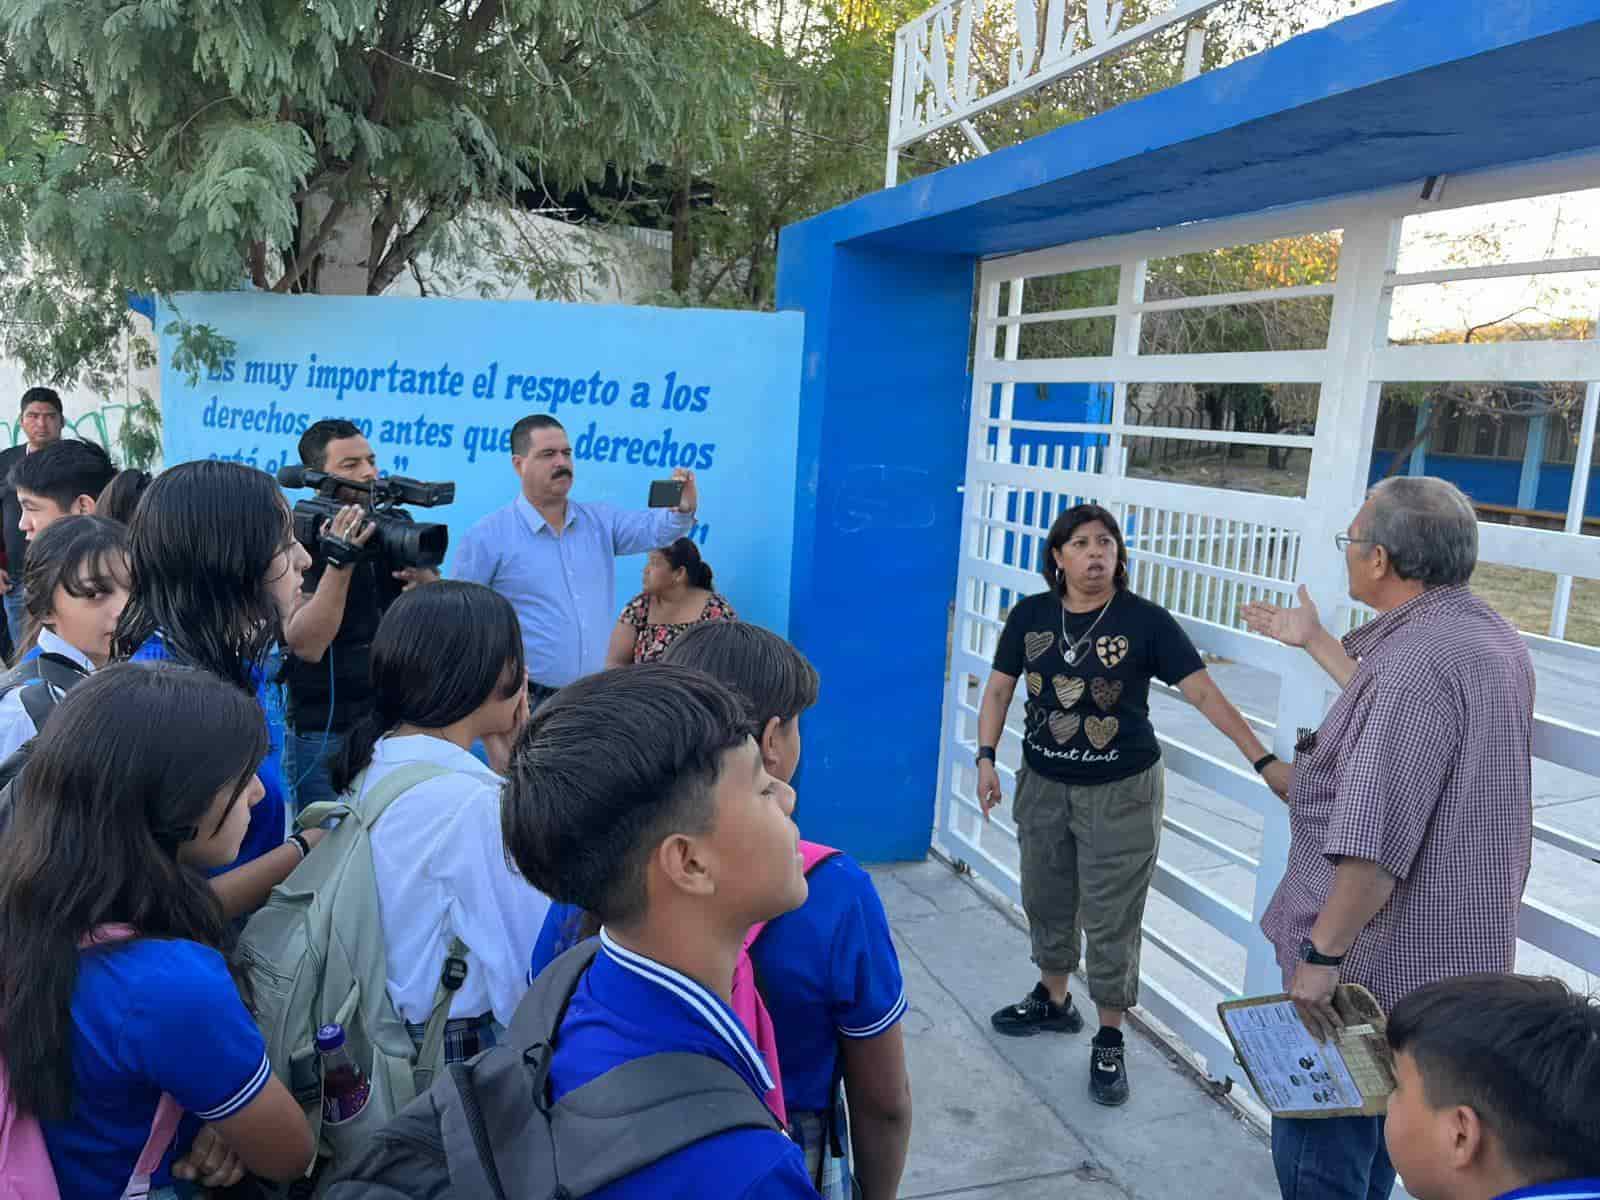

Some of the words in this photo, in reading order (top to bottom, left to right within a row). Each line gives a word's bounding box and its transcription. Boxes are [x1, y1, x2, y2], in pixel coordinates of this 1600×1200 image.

[243, 358, 298, 391] muy
[305, 353, 464, 400] importante
[472, 361, 498, 399] el
[504, 370, 620, 414] respeto
[630, 381, 650, 409] a
[661, 371, 711, 412] los
[379, 413, 453, 449] antes
[463, 423, 512, 463] que
[575, 422, 716, 470] derechos
[1081, 749, 1121, 762] heart
